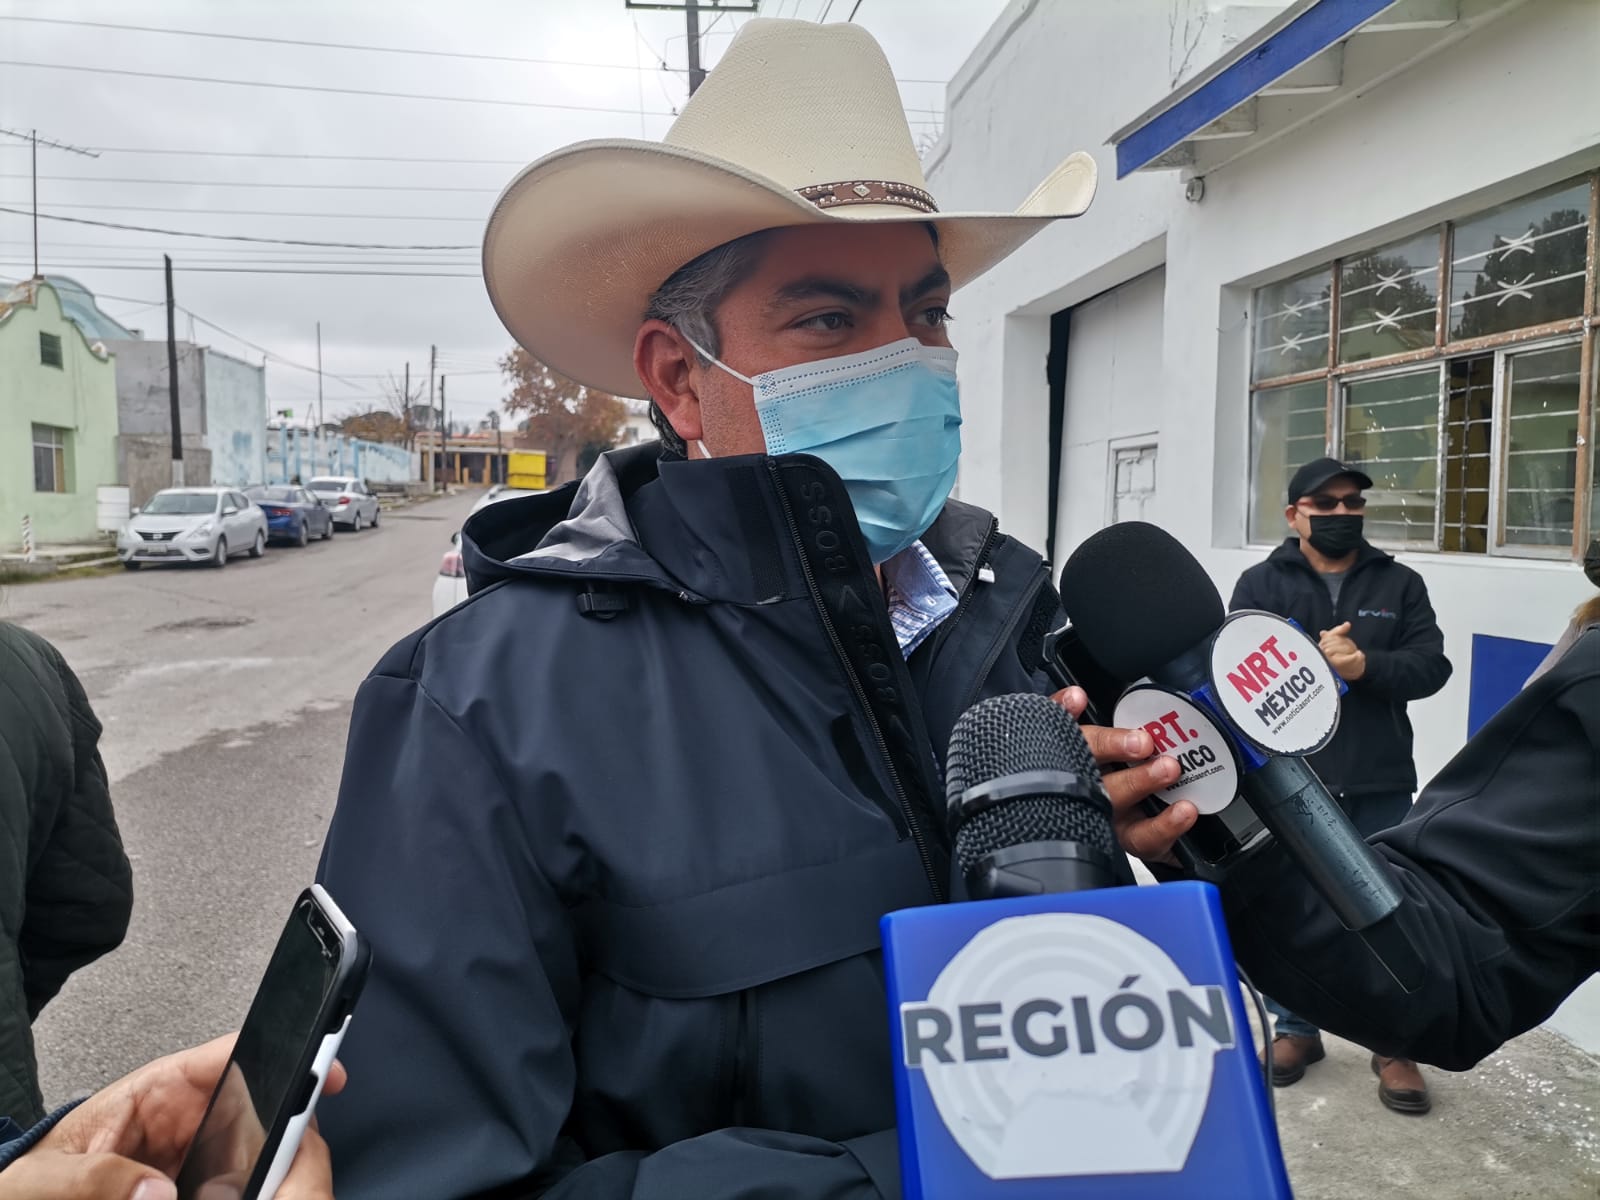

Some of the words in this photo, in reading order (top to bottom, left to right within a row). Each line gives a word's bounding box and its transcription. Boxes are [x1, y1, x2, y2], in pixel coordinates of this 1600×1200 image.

[801, 480, 849, 573] BOSS
[1227, 635, 1298, 703] NRT.
[1254, 666, 1316, 727] MÉXICO
[1271, 684, 1325, 735] www.noticiasnrt.com
[1177, 744, 1216, 775] XICO
[904, 974, 1233, 1066] REGIÓN
